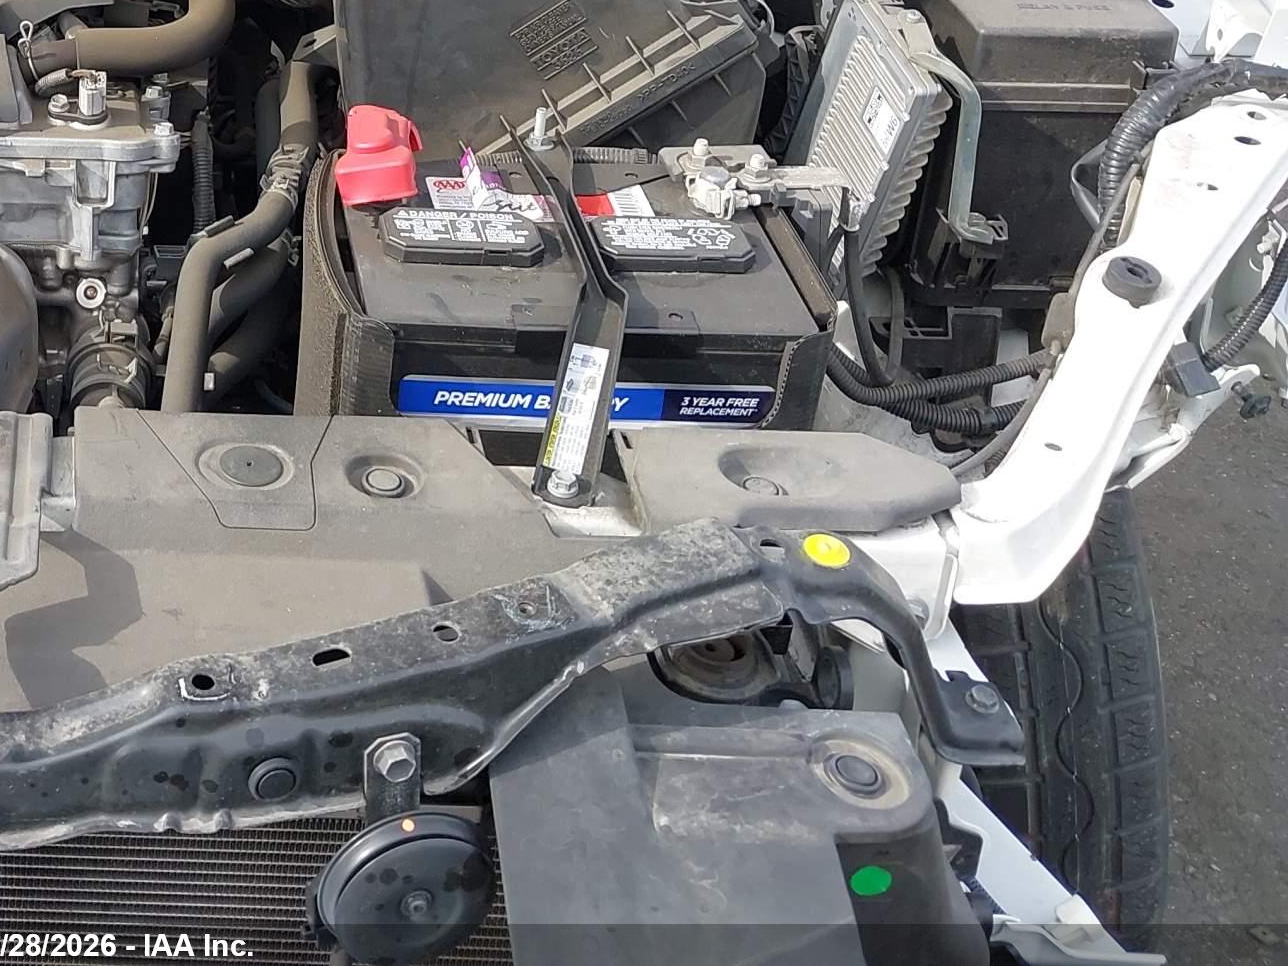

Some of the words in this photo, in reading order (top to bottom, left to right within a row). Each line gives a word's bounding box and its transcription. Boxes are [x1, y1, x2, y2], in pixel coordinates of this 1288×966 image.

[533, 30, 589, 68] TOYOTA
[433, 180, 465, 191] AAA
[409, 209, 457, 219] DANGER
[470, 211, 514, 221] POISON
[433, 390, 533, 409] PREMIUM
[681, 396, 691, 406] 3
[692, 396, 724, 407] YEAR
[726, 397, 760, 408] FREE
